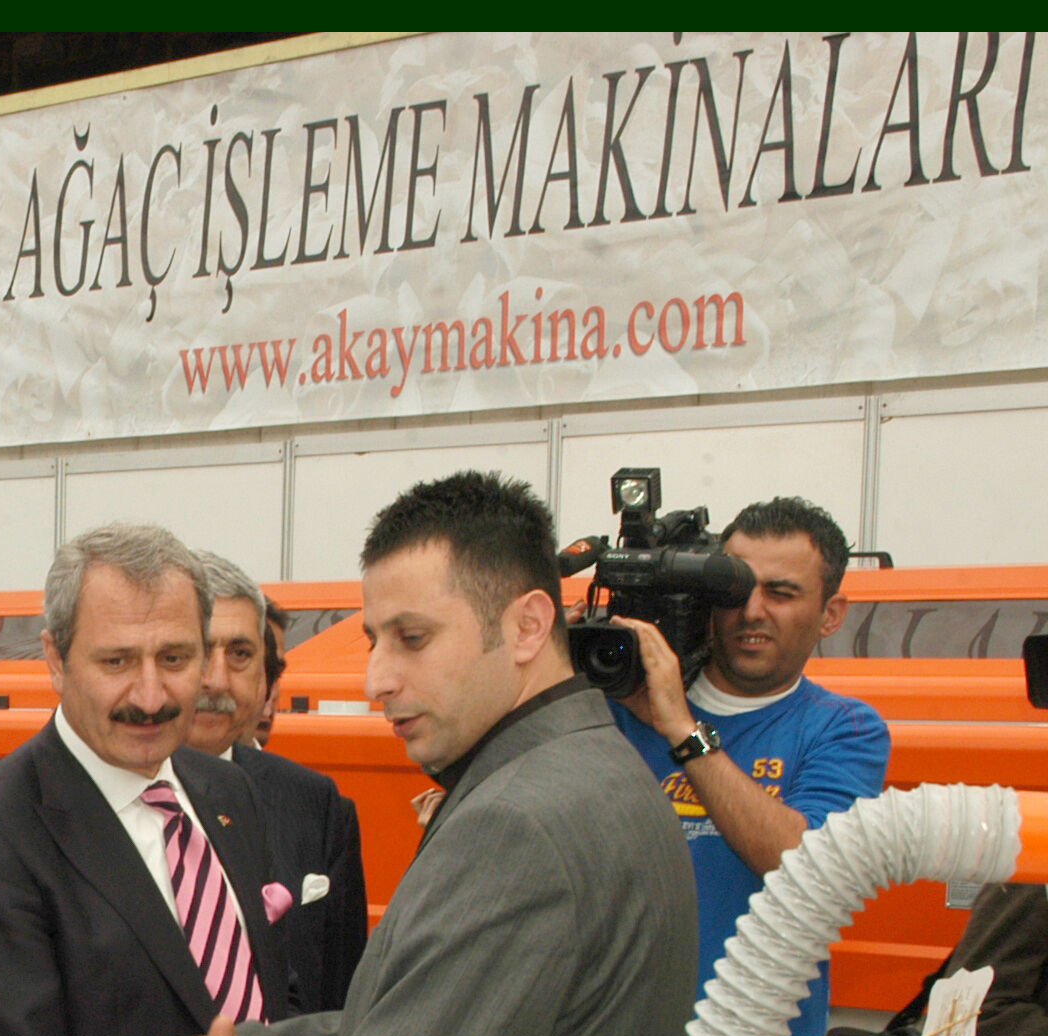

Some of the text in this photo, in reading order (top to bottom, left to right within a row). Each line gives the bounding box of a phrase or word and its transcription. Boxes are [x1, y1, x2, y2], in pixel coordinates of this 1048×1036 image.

[3, 120, 182, 323] AĞAÇ
[192, 103, 447, 315] İŞLEME
[180, 288, 747, 398] www.akaymakina.com
[753, 758, 784, 779] 53
